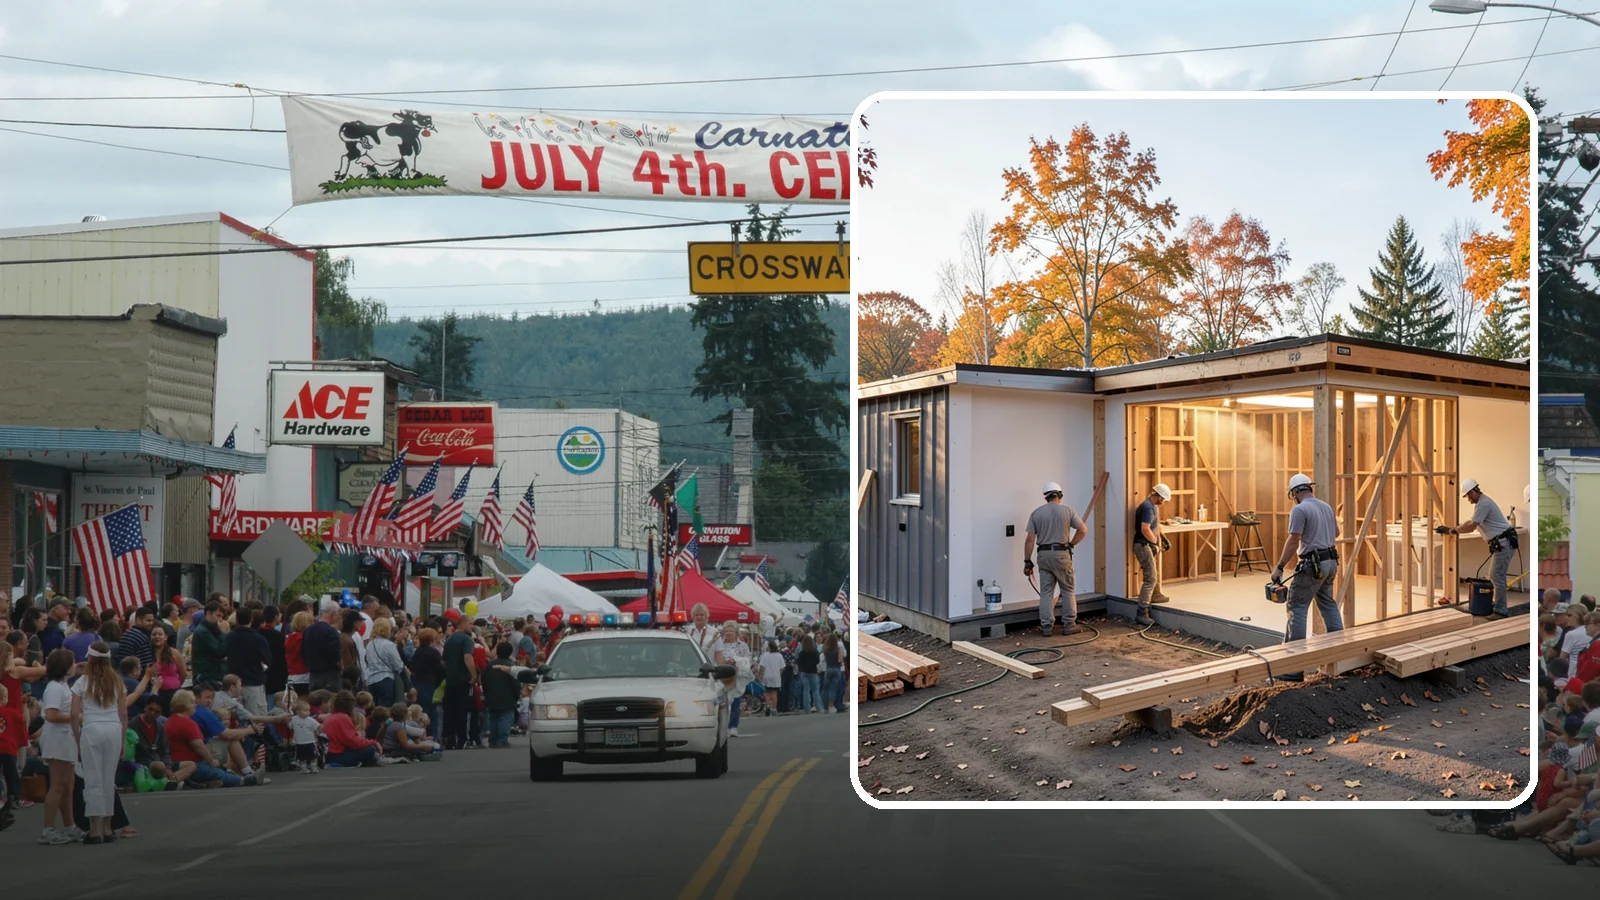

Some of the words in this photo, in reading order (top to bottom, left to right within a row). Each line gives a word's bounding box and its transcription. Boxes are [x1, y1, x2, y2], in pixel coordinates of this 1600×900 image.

[481, 141, 604, 192] JULY
[632, 150, 746, 198] 4th.
[697, 254, 850, 280] CROSSWA
[283, 380, 373, 420] ACE
[405, 409, 452, 422] CEDAR
[461, 409, 485, 422] LOG
[284, 421, 370, 436] Hardware
[416, 428, 477, 447] Coca-Cola
[353, 467, 386, 480] Simpl
[83, 485, 93, 494] St.
[96, 485, 124, 495] Vincent
[126, 486, 136, 495] de
[138, 486, 155, 495] Paul
[688, 526, 741, 535] CRNATION
[699, 535, 730, 543] GLASS
